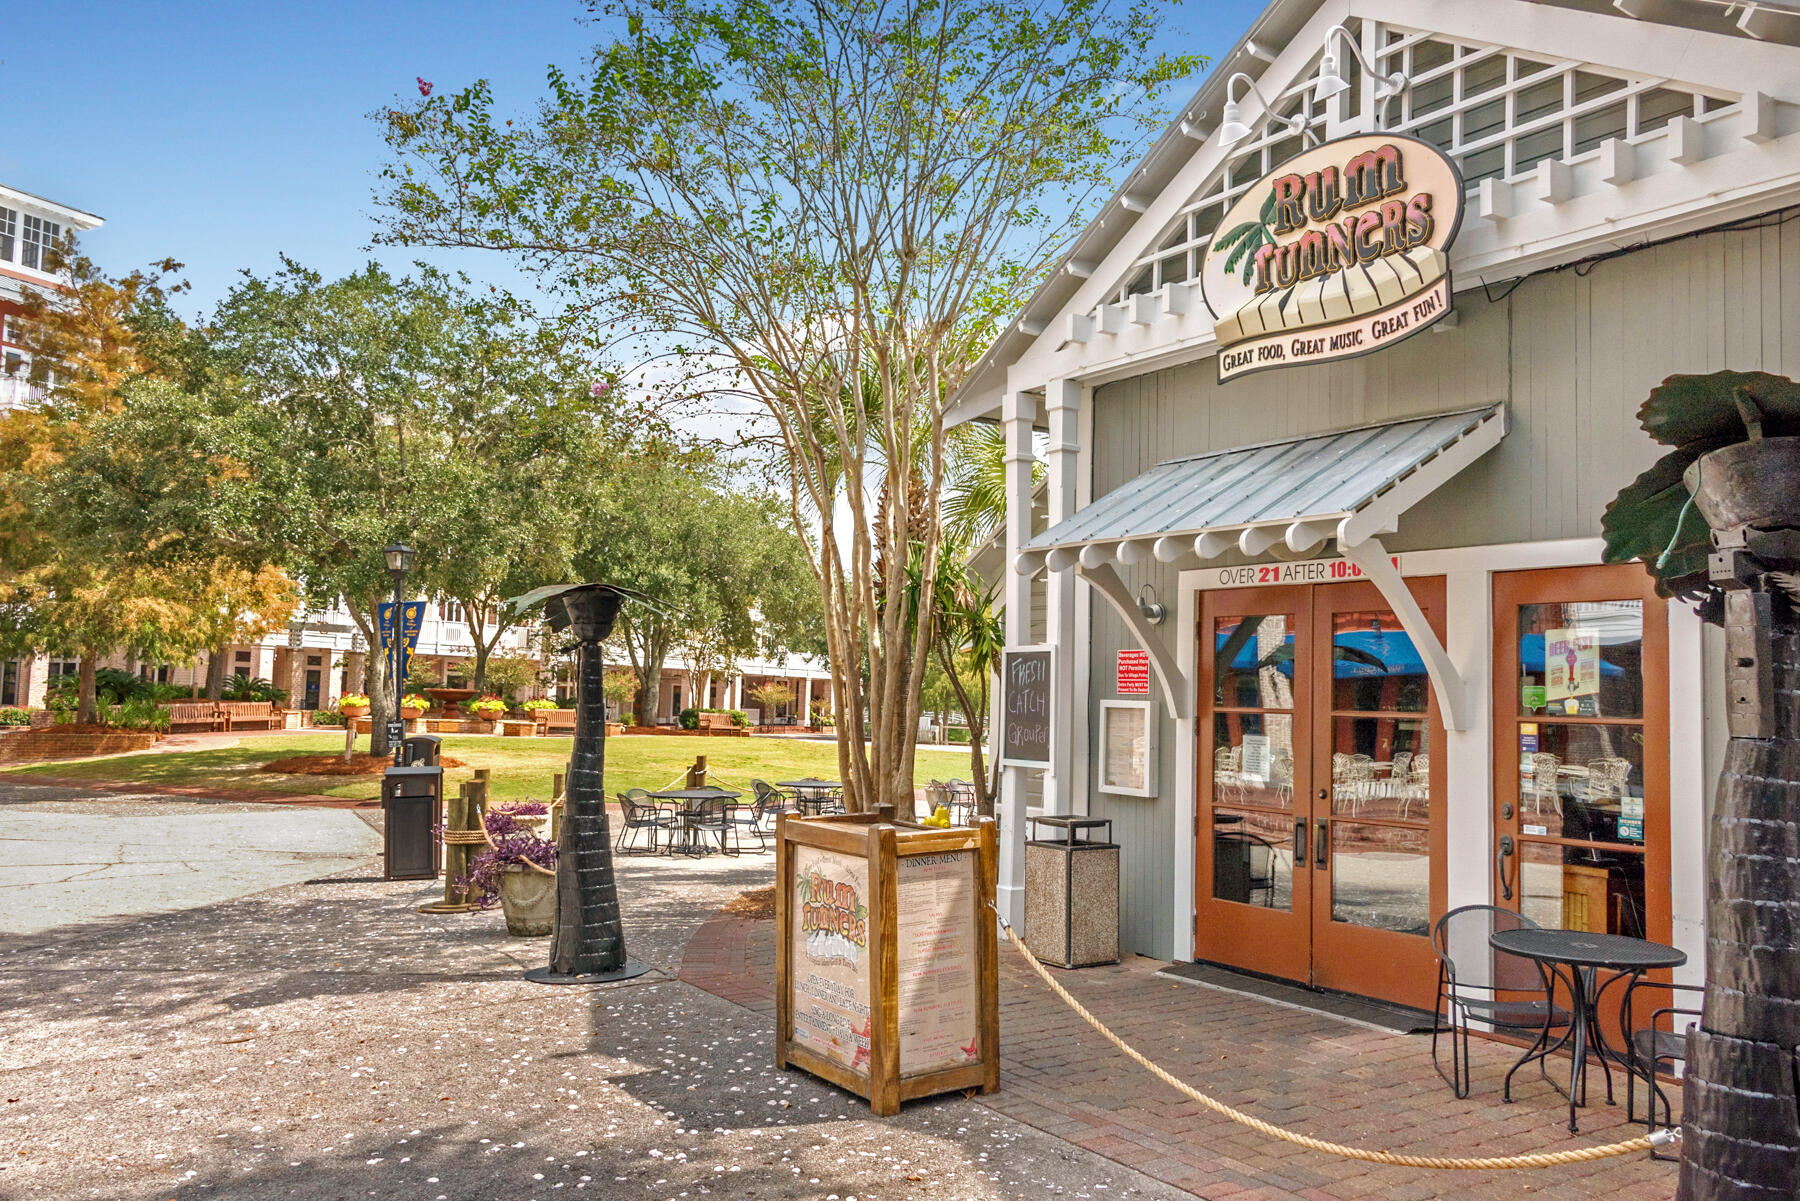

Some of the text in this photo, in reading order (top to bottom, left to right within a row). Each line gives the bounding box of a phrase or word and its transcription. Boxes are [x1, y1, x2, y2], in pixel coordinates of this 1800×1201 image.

[1223, 349, 1253, 371] GREAT
[1258, 345, 1286, 360] FOOD,
[1291, 338, 1324, 356] GREAT
[1329, 329, 1363, 352] MUSIC
[1371, 311, 1409, 340] GREAT
[1219, 568, 1255, 585] OVER
[1258, 566, 1280, 582] 21
[1282, 562, 1325, 581] AFTER
[1007, 689, 1046, 716] CATCH
[906, 852, 963, 868] DINNER MENU
